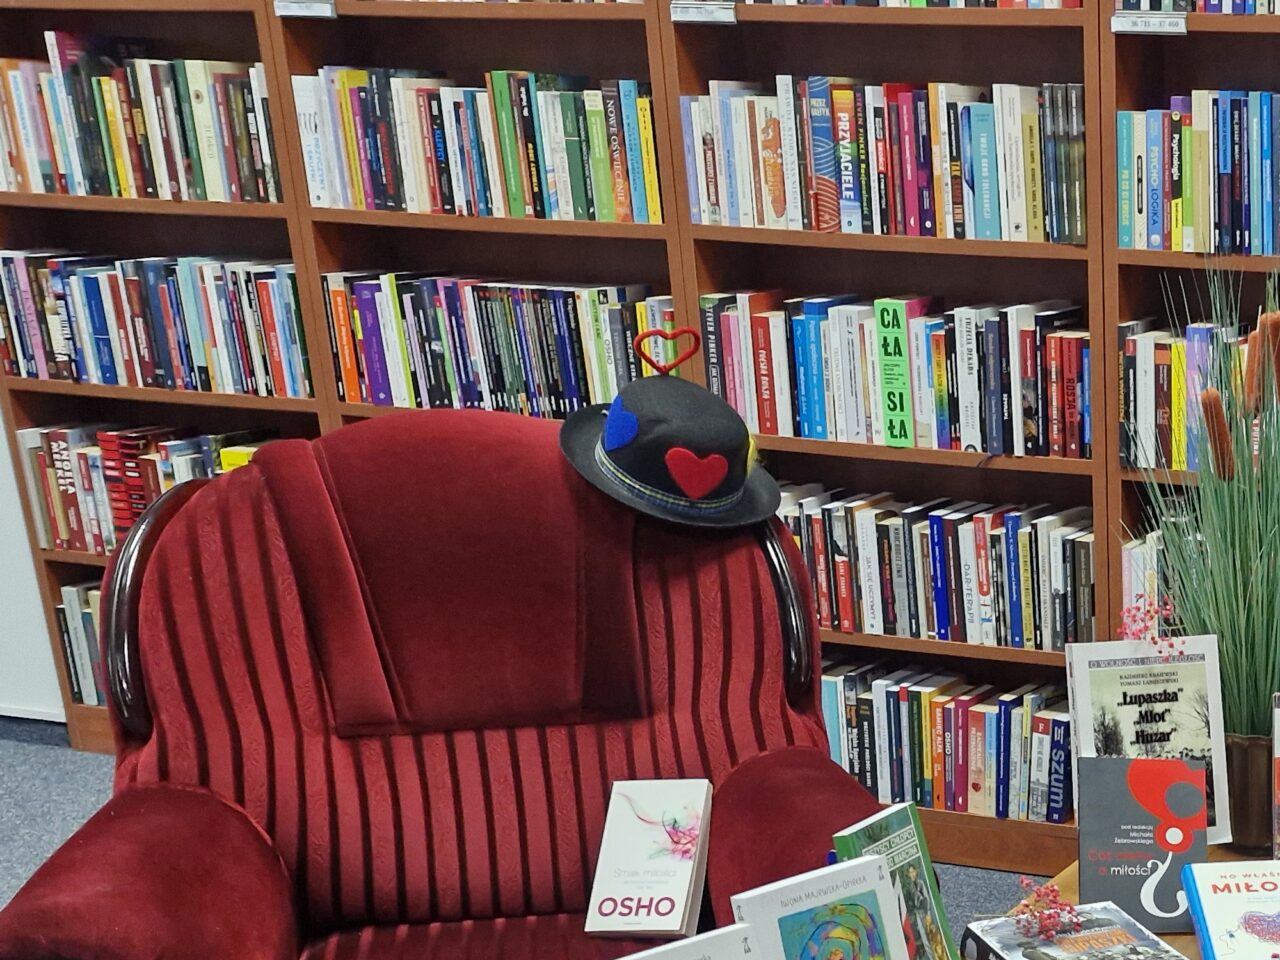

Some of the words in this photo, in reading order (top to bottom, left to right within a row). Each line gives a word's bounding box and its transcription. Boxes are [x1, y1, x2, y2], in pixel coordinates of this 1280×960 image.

[606, 100, 618, 133] NOWE
[856, 93, 864, 124] STEVEN
[838, 112, 854, 199] PRZYJACIELE
[858, 128, 866, 160] PINKER
[1172, 134, 1180, 180] Psychologia
[610, 135, 625, 201] OŚWIECENIE
[1151, 188, 1160, 226] LOGIKA
[706, 304, 716, 332] STEVEN
[880, 308, 901, 329] CA
[604, 339, 613, 365] OSHO
[708, 335, 717, 363] PINKER
[882, 336, 903, 357] ŁA
[887, 391, 905, 413] SI
[1065, 378, 1076, 410] ROSJA
[887, 418, 909, 440] ŁA
[50, 441, 67, 492] MERKEL
[57, 441, 76, 494] ANGELA
[1050, 749, 1065, 808] szum
[1110, 864, 1151, 876] miłości
[598, 896, 676, 918] OSHO
